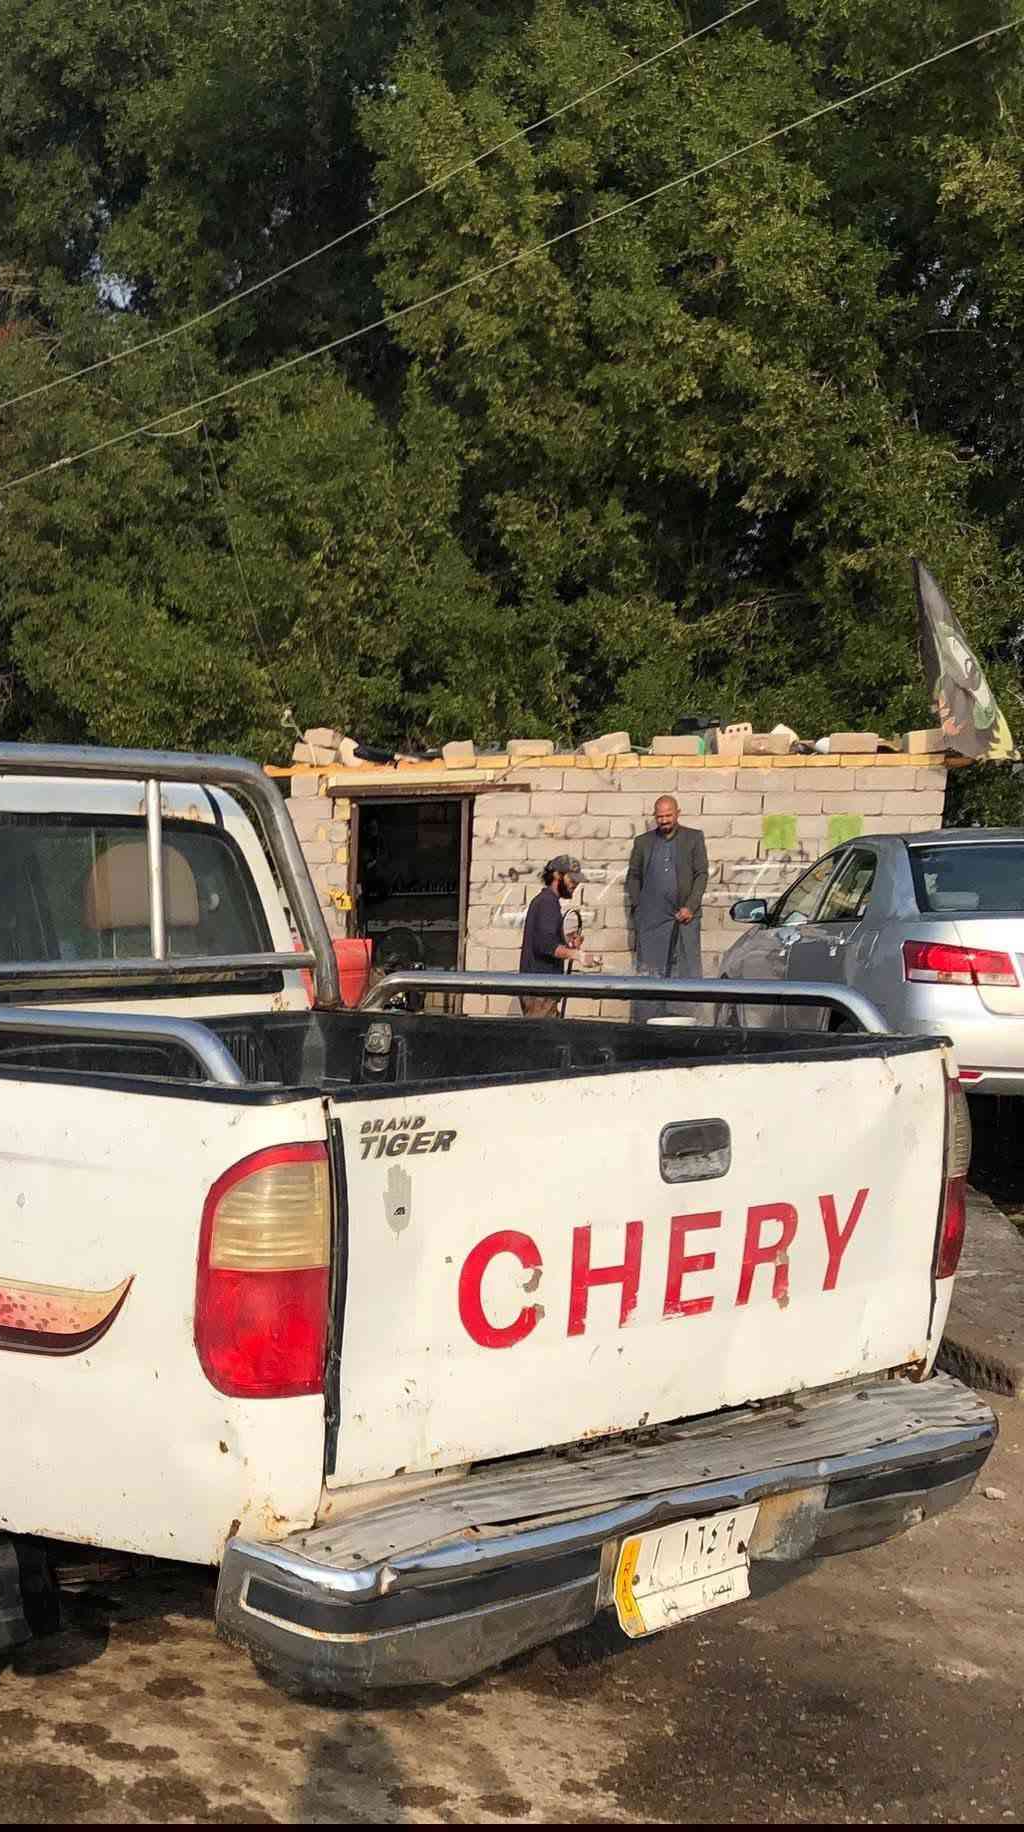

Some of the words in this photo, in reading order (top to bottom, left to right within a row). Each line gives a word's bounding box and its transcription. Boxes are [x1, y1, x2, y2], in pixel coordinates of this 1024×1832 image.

[360, 1115, 427, 1135] GRAND
[360, 1130, 458, 1161] TIGER
[458, 1188, 869, 1349] CHERY
